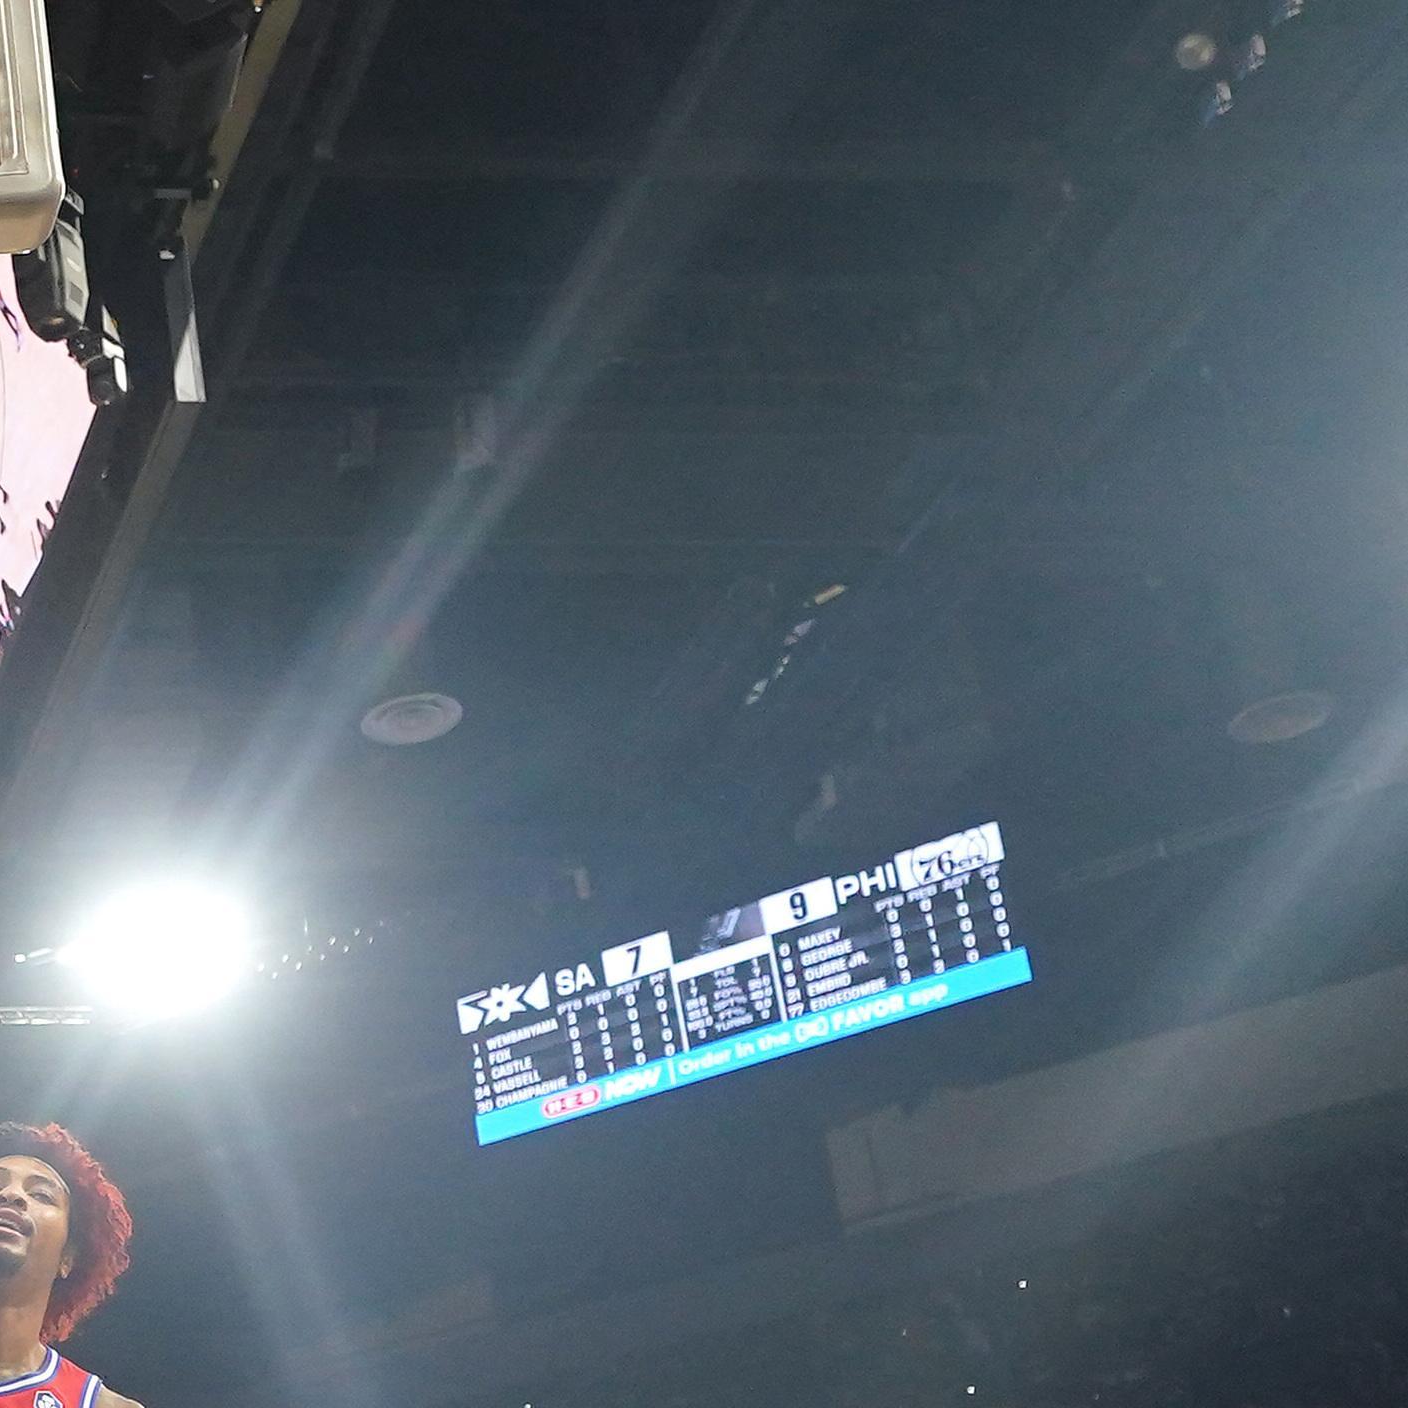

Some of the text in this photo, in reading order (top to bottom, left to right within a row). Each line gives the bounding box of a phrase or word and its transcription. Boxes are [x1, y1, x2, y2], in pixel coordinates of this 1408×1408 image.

[789, 850, 984, 920] 9 PHI 76ers
[798, 925, 841, 951] MAXEY
[800, 938, 853, 967] GEORGE
[555, 945, 641, 996] SA 7
[803, 957, 847, 981] OUBRE
[788, 977, 887, 1018] 77 EDGECOMBE
[806, 972, 852, 997] EMBIID
[486, 1017, 558, 1051] WEMBANYAMA
[678, 1048, 732, 1076] Order
[735, 1041, 756, 1058] in
[758, 1030, 791, 1051] the
[831, 993, 905, 1031] FAVOR
[908, 983, 950, 1010] app
[488, 1047, 512, 1066] FOX
[491, 1055, 533, 1080] CASTLE
[493, 1069, 541, 1094] VASSELL
[495, 1075, 568, 1109] CHAMPAGNIE
